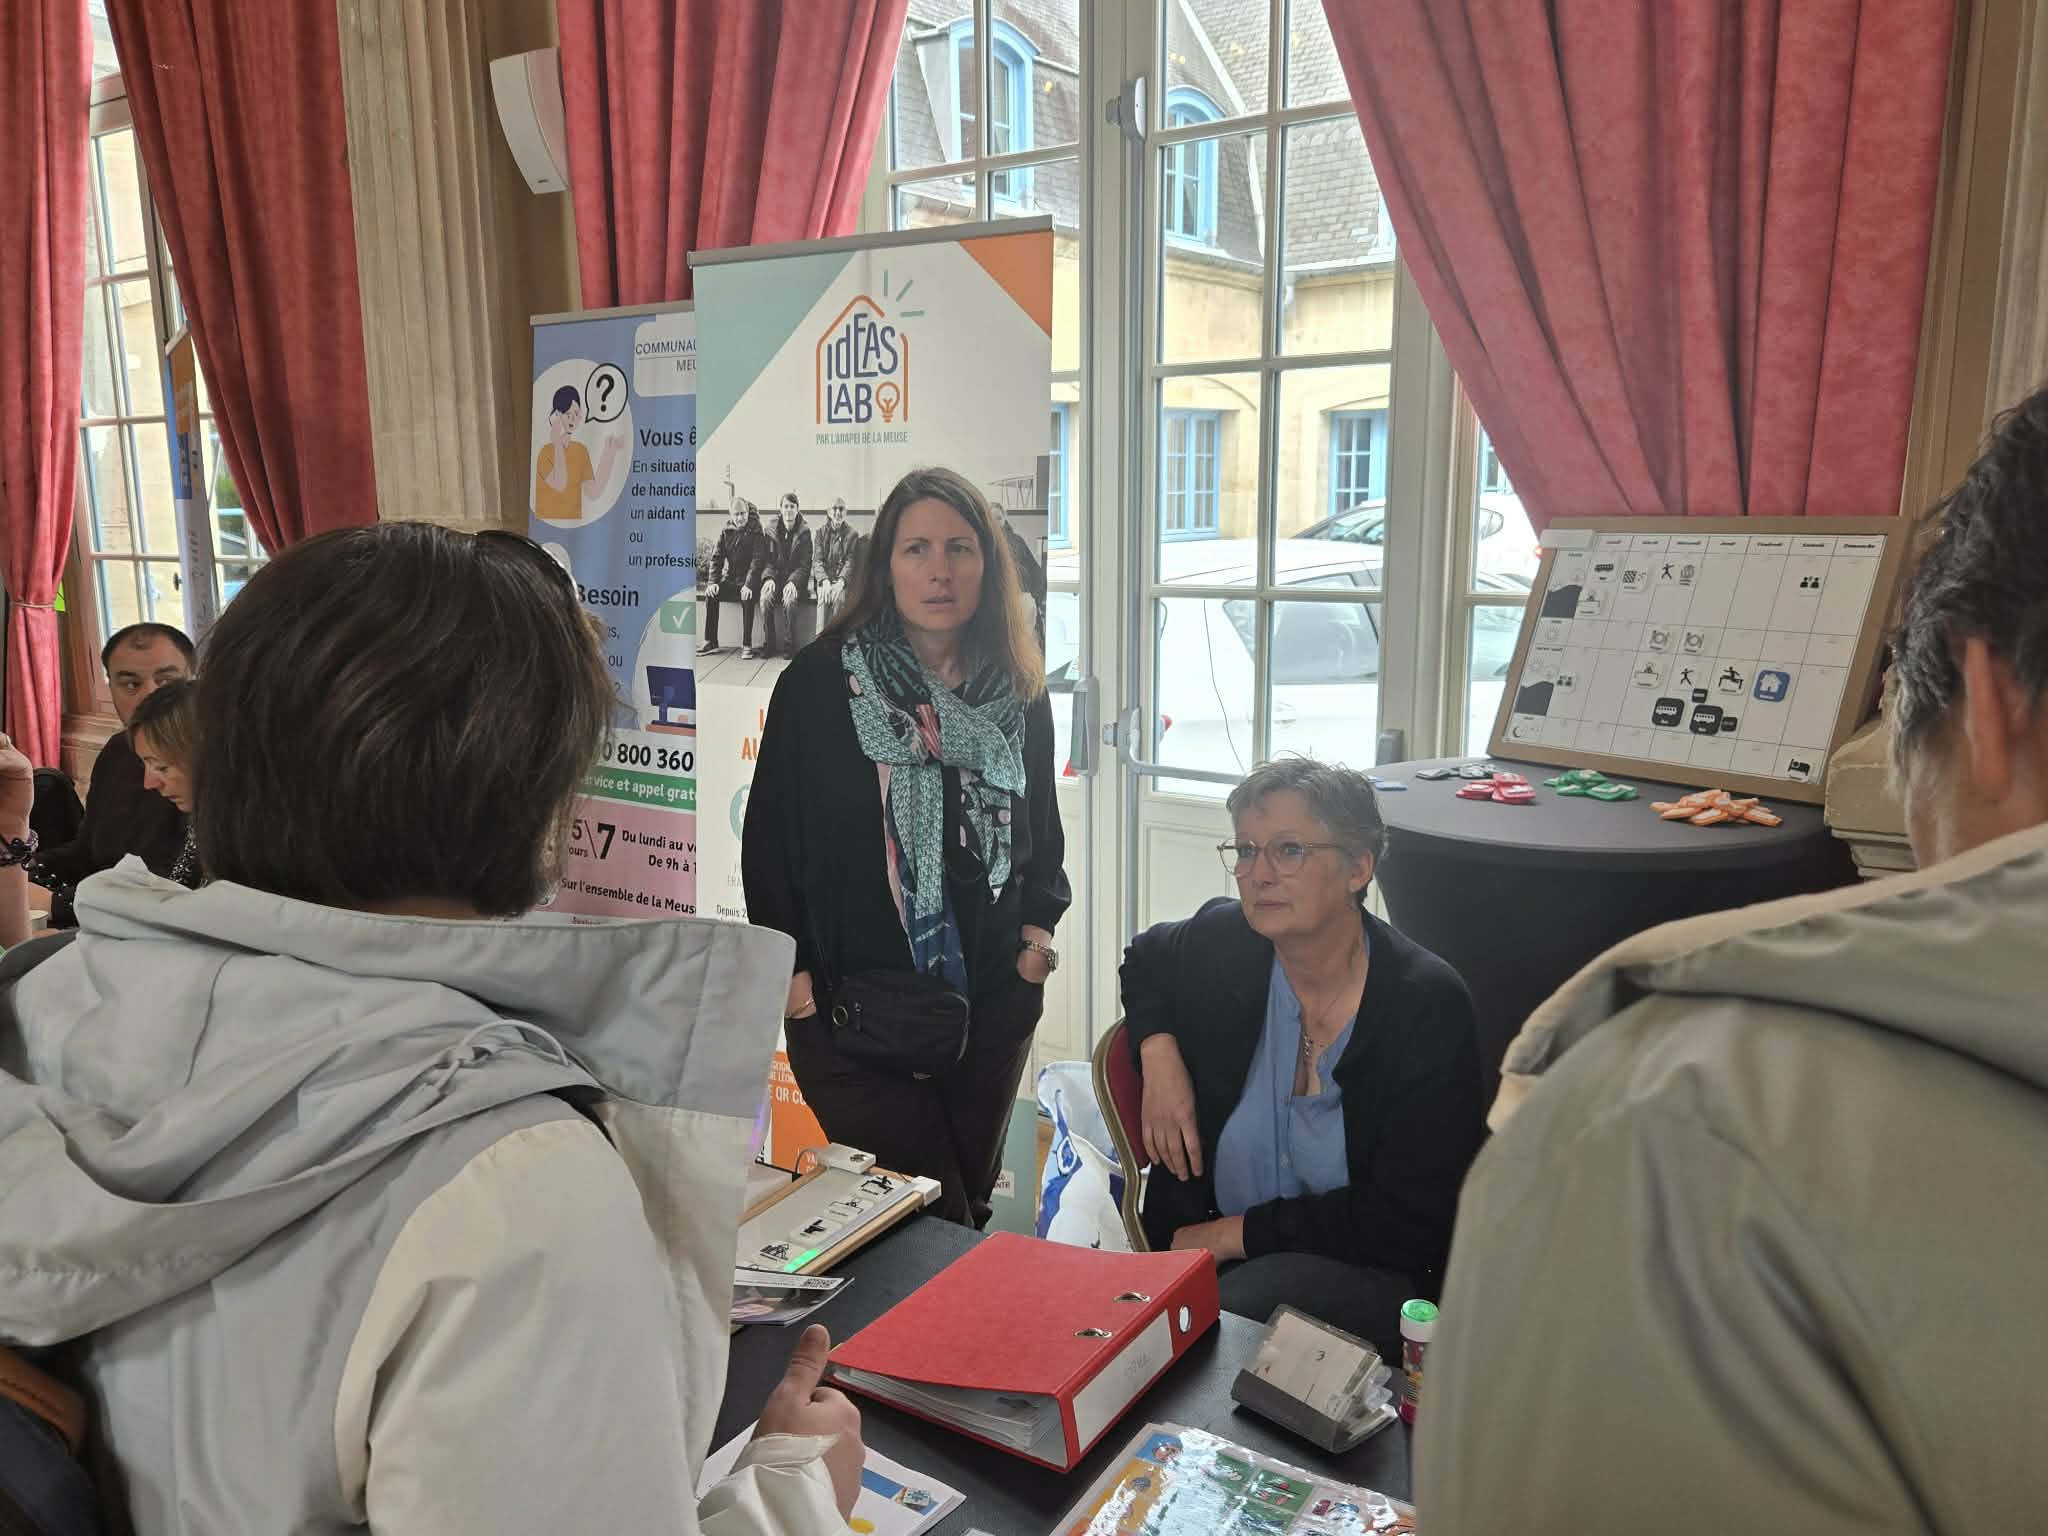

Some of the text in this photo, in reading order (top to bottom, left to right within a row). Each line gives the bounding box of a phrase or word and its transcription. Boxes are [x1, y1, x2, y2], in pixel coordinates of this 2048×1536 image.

[639, 428, 684, 448] Vous
[883, 431, 909, 443] MEUSE
[632, 458, 697, 473] En situatio
[631, 484, 646, 497] de
[630, 506, 686, 521] un aidant
[629, 531, 644, 544] ou
[628, 555, 643, 567] un
[608, 655, 623, 668] ou
[617, 743, 652, 766] 800
[656, 748, 694, 772] 360
[616, 778, 631, 792] et
[632, 783, 664, 798] appel
[667, 788, 697, 802] grat
[622, 830, 636, 843] Du
[639, 831, 666, 849] lundi
[668, 840, 683, 852] au
[648, 854, 663, 868] De
[665, 857, 679, 871] 9h
[682, 860, 690, 873] à
[579, 880, 634, 903] l'ensemble
[636, 892, 649, 907] de
[651, 895, 662, 908] la
[665, 899, 697, 914] Meus
[716, 904, 741, 919] Depuis
[775, 1086, 789, 1103] QR
